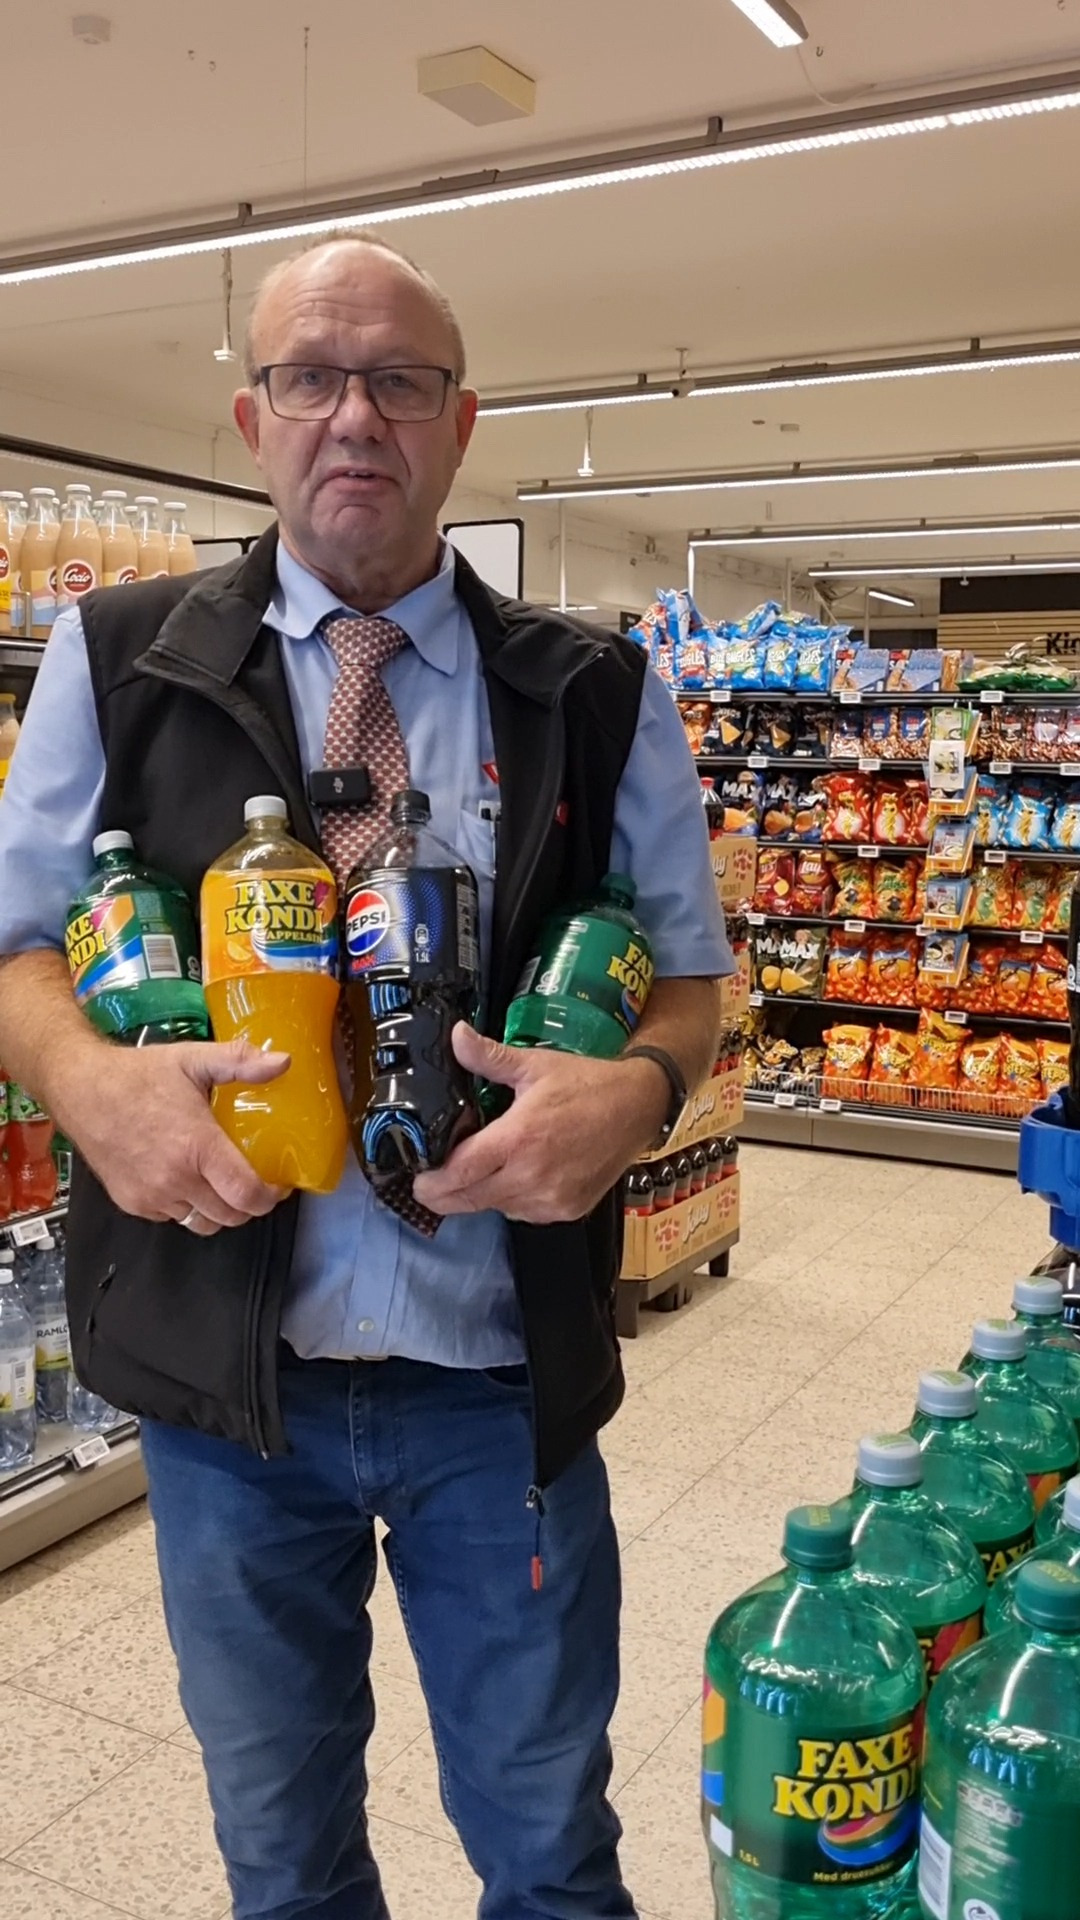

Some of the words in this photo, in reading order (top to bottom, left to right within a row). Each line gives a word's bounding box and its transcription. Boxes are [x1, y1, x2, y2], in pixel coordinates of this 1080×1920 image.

[63, 568, 93, 584] Cocio
[236, 880, 315, 906] FAXE
[225, 905, 325, 935] KONDI
[797, 1724, 913, 1779] FAXE
[773, 1760, 917, 1820] KONDI
[813, 1870, 839, 1882] Med
